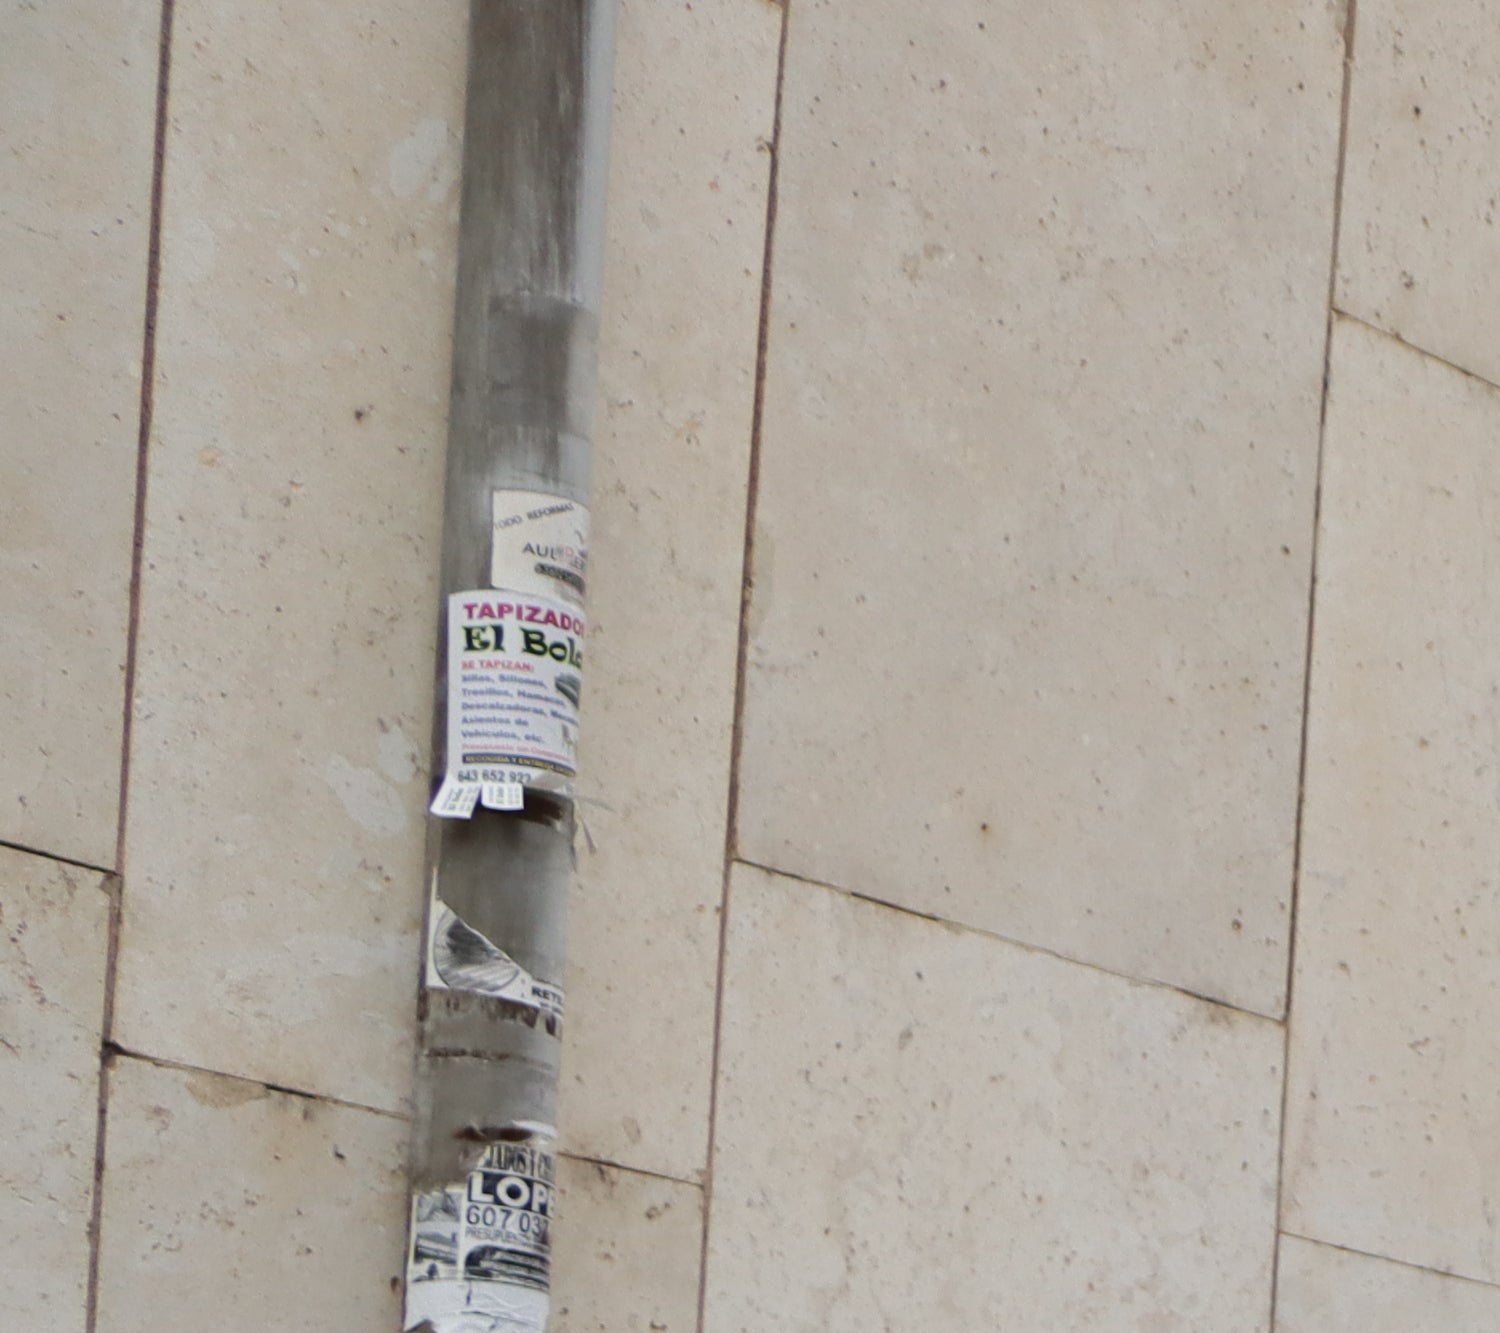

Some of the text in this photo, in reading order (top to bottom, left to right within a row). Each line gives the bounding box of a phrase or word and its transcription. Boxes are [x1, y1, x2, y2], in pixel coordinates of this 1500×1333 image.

[463, 602, 584, 636] TAPIZADO
[461, 624, 506, 652] El
[467, 1205, 512, 1231] 607
